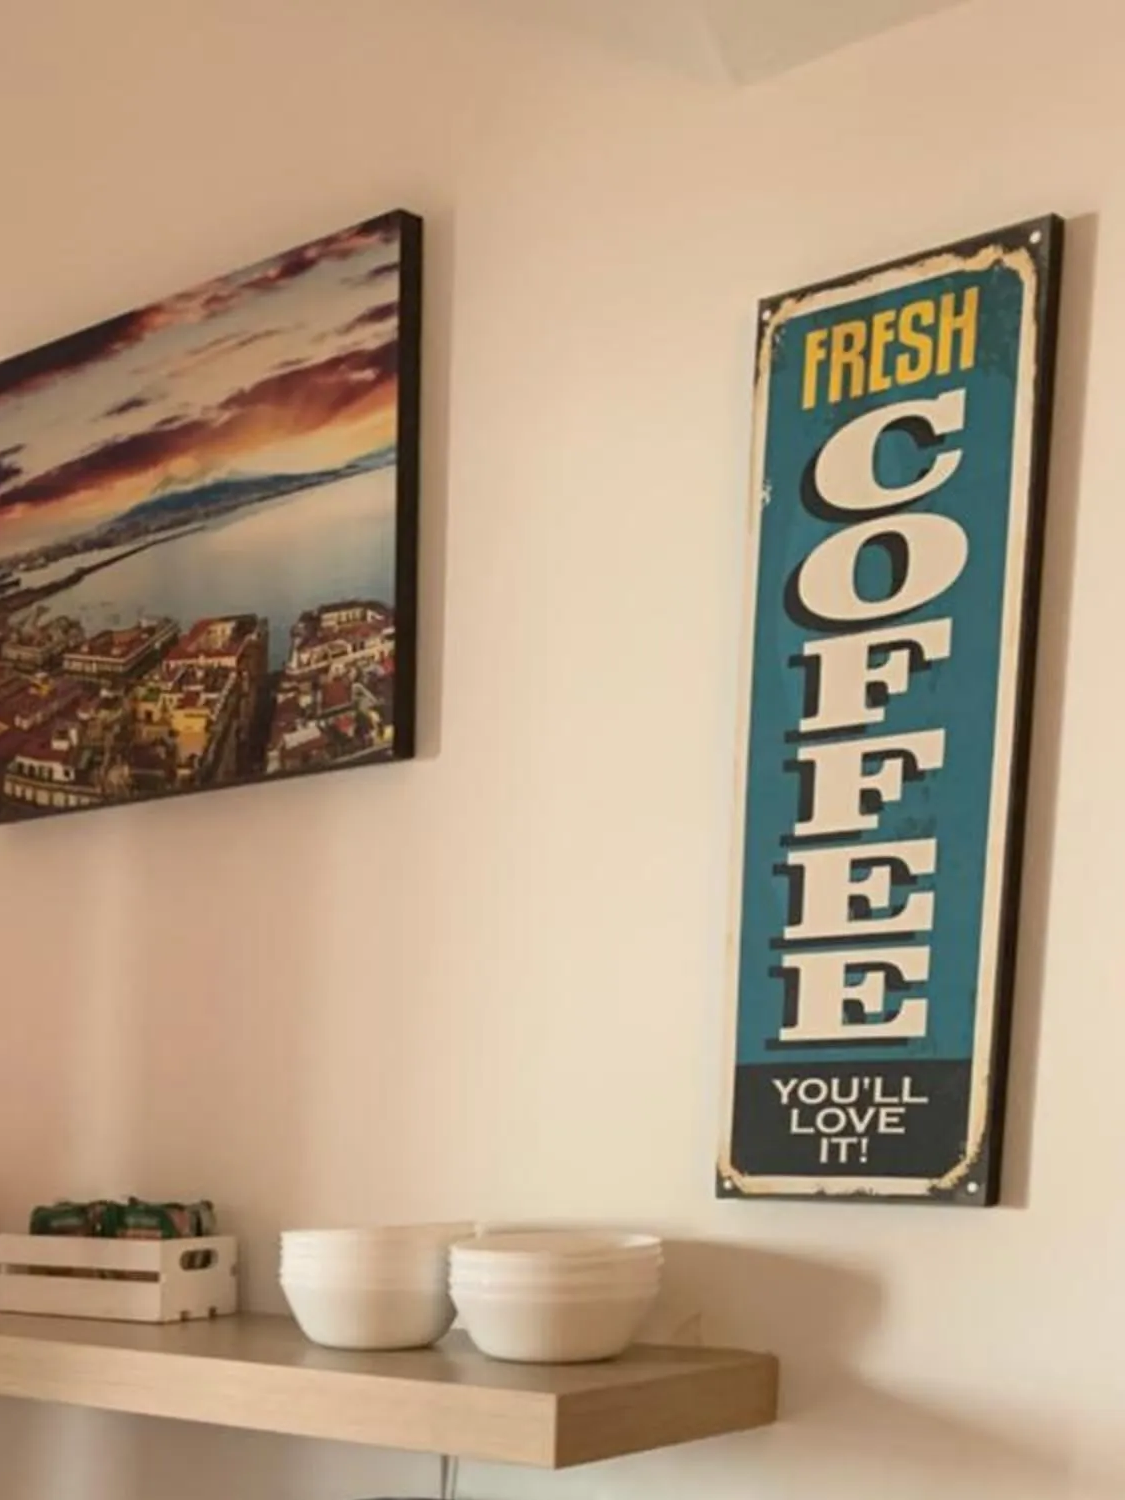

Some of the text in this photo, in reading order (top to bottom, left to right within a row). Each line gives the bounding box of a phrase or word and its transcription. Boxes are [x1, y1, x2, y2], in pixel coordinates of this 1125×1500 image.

[801, 285, 980, 411] FRESH
[777, 388, 970, 1043] COFFEE
[771, 1076, 930, 1105] YOU'LL
[789, 1106, 907, 1134] LOVE
[819, 1136, 870, 1164] IT!
